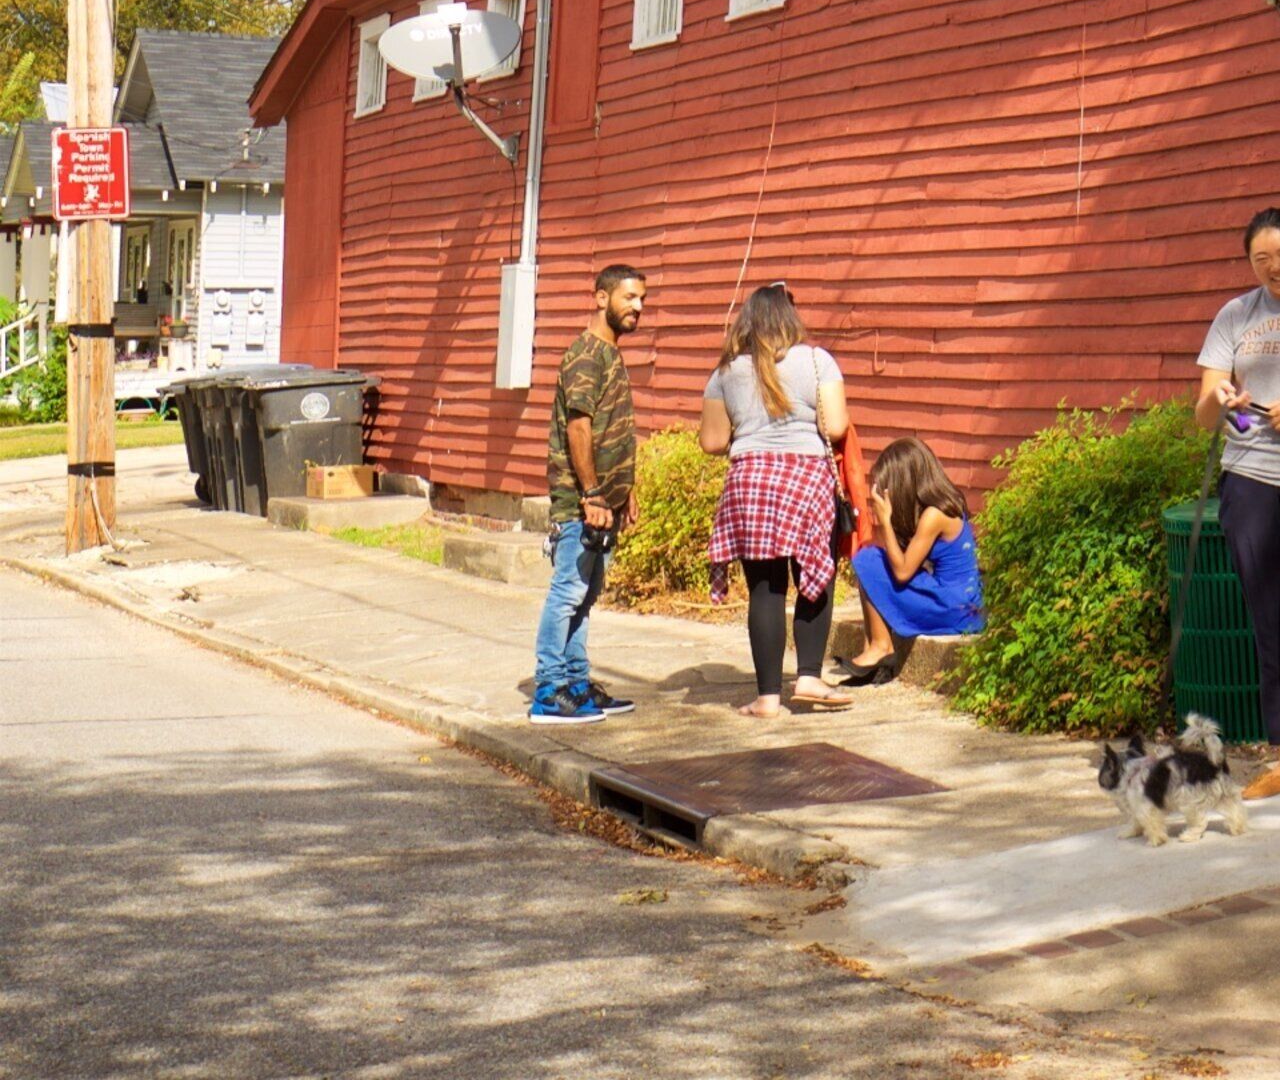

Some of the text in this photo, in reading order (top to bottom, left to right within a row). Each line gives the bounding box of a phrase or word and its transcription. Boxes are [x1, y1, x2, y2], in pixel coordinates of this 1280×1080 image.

[69, 131, 110, 144] Spanish
[79, 143, 104, 153] Town
[73, 163, 109, 173] Permit
[68, 172, 115, 183] Required
